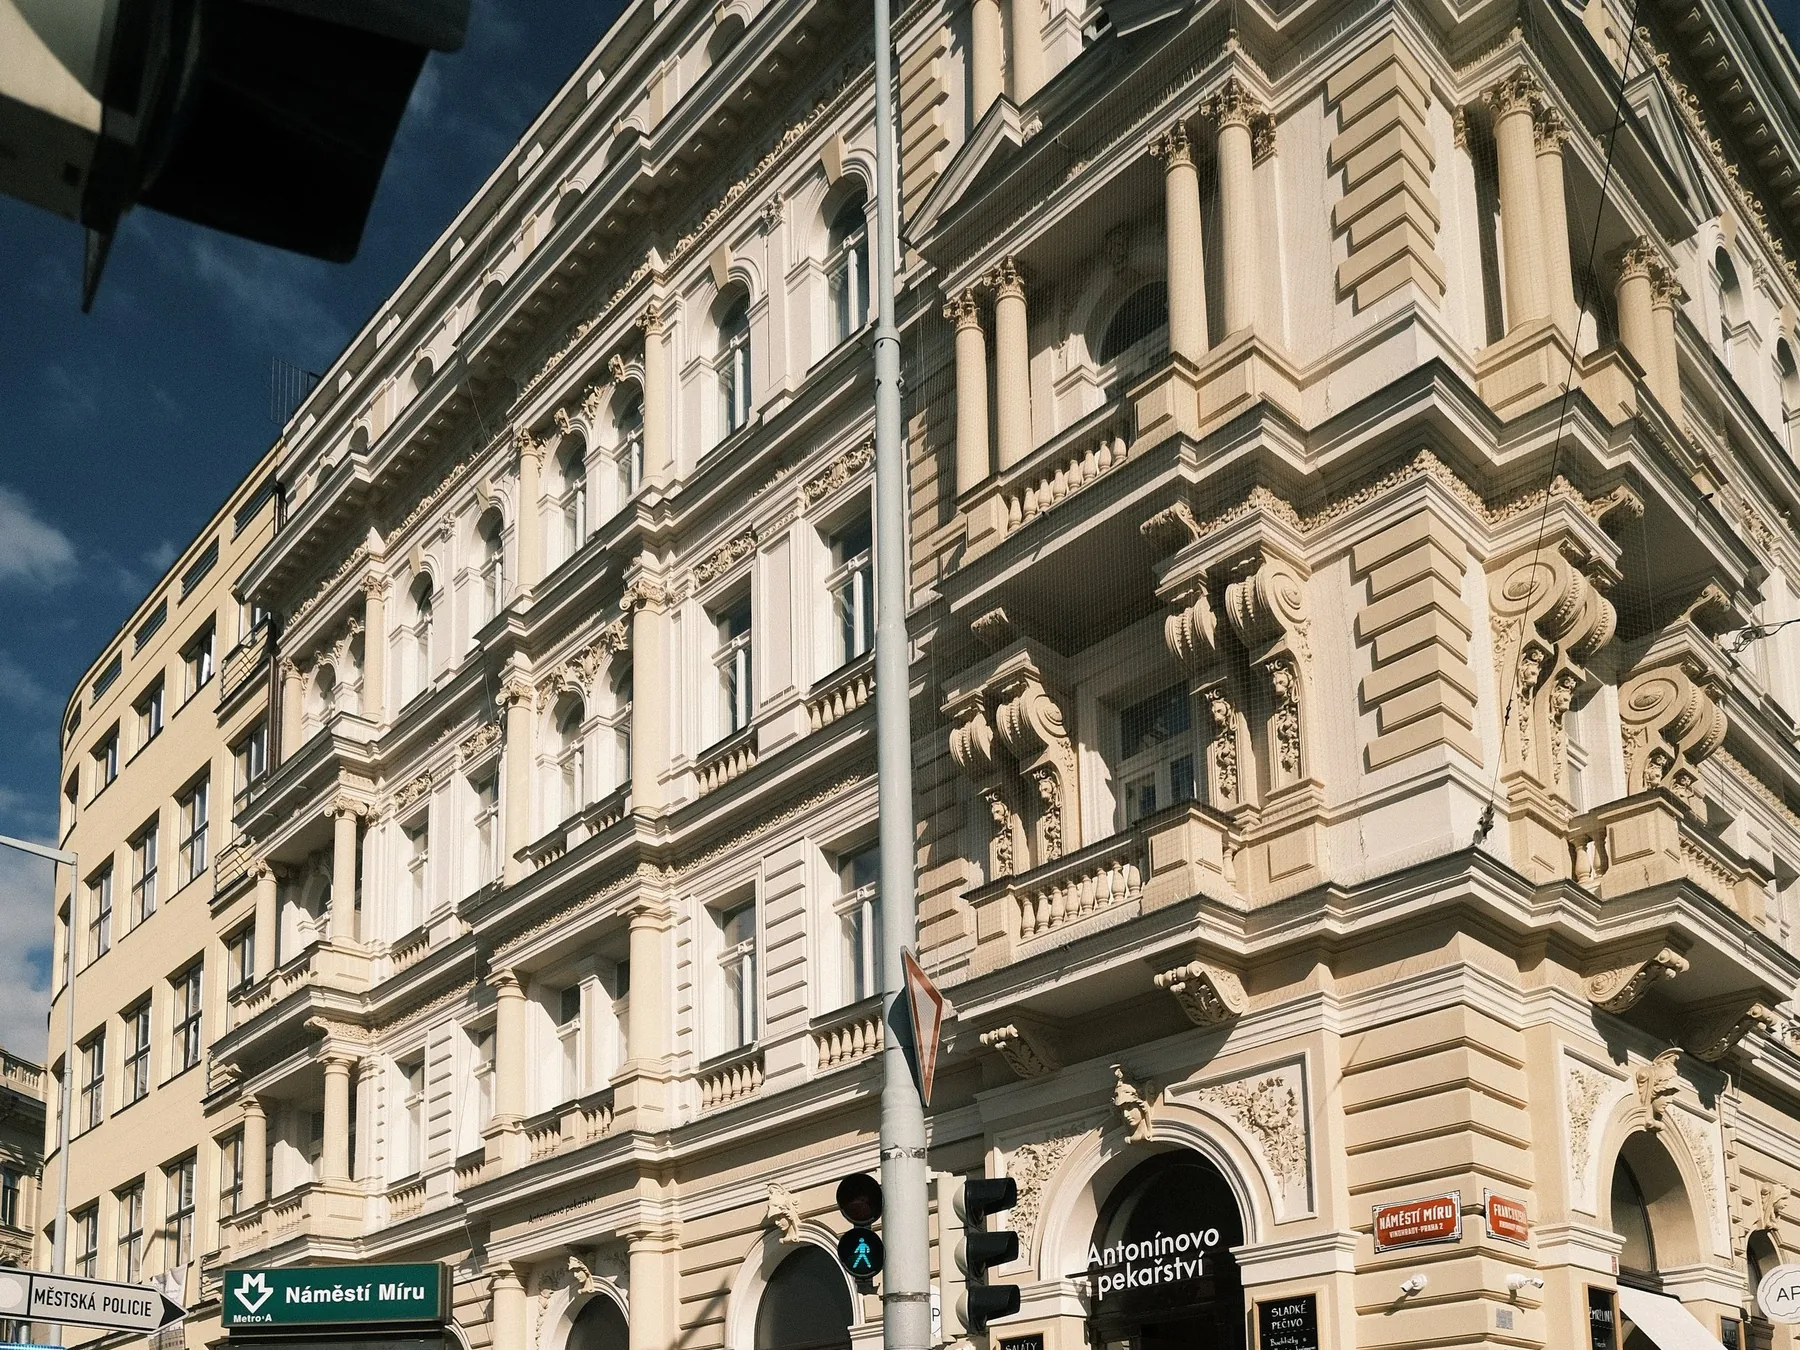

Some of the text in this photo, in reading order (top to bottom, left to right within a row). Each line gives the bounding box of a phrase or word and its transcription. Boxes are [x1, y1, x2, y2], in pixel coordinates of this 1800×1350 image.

[1380, 1205, 1452, 1230] NÁMĚSTÍ MÍRU
[1086, 1228, 1219, 1268] Antonínovo
[1098, 1250, 1205, 1300] pekařství
[34, 1286, 152, 1317] MĚSTSKÁ POLICIE
[286, 1283, 425, 1303] Náměstí Míru
[1271, 1300, 1307, 1317] SLADKÉ
[1271, 1318, 1303, 1330] PEČIVO
